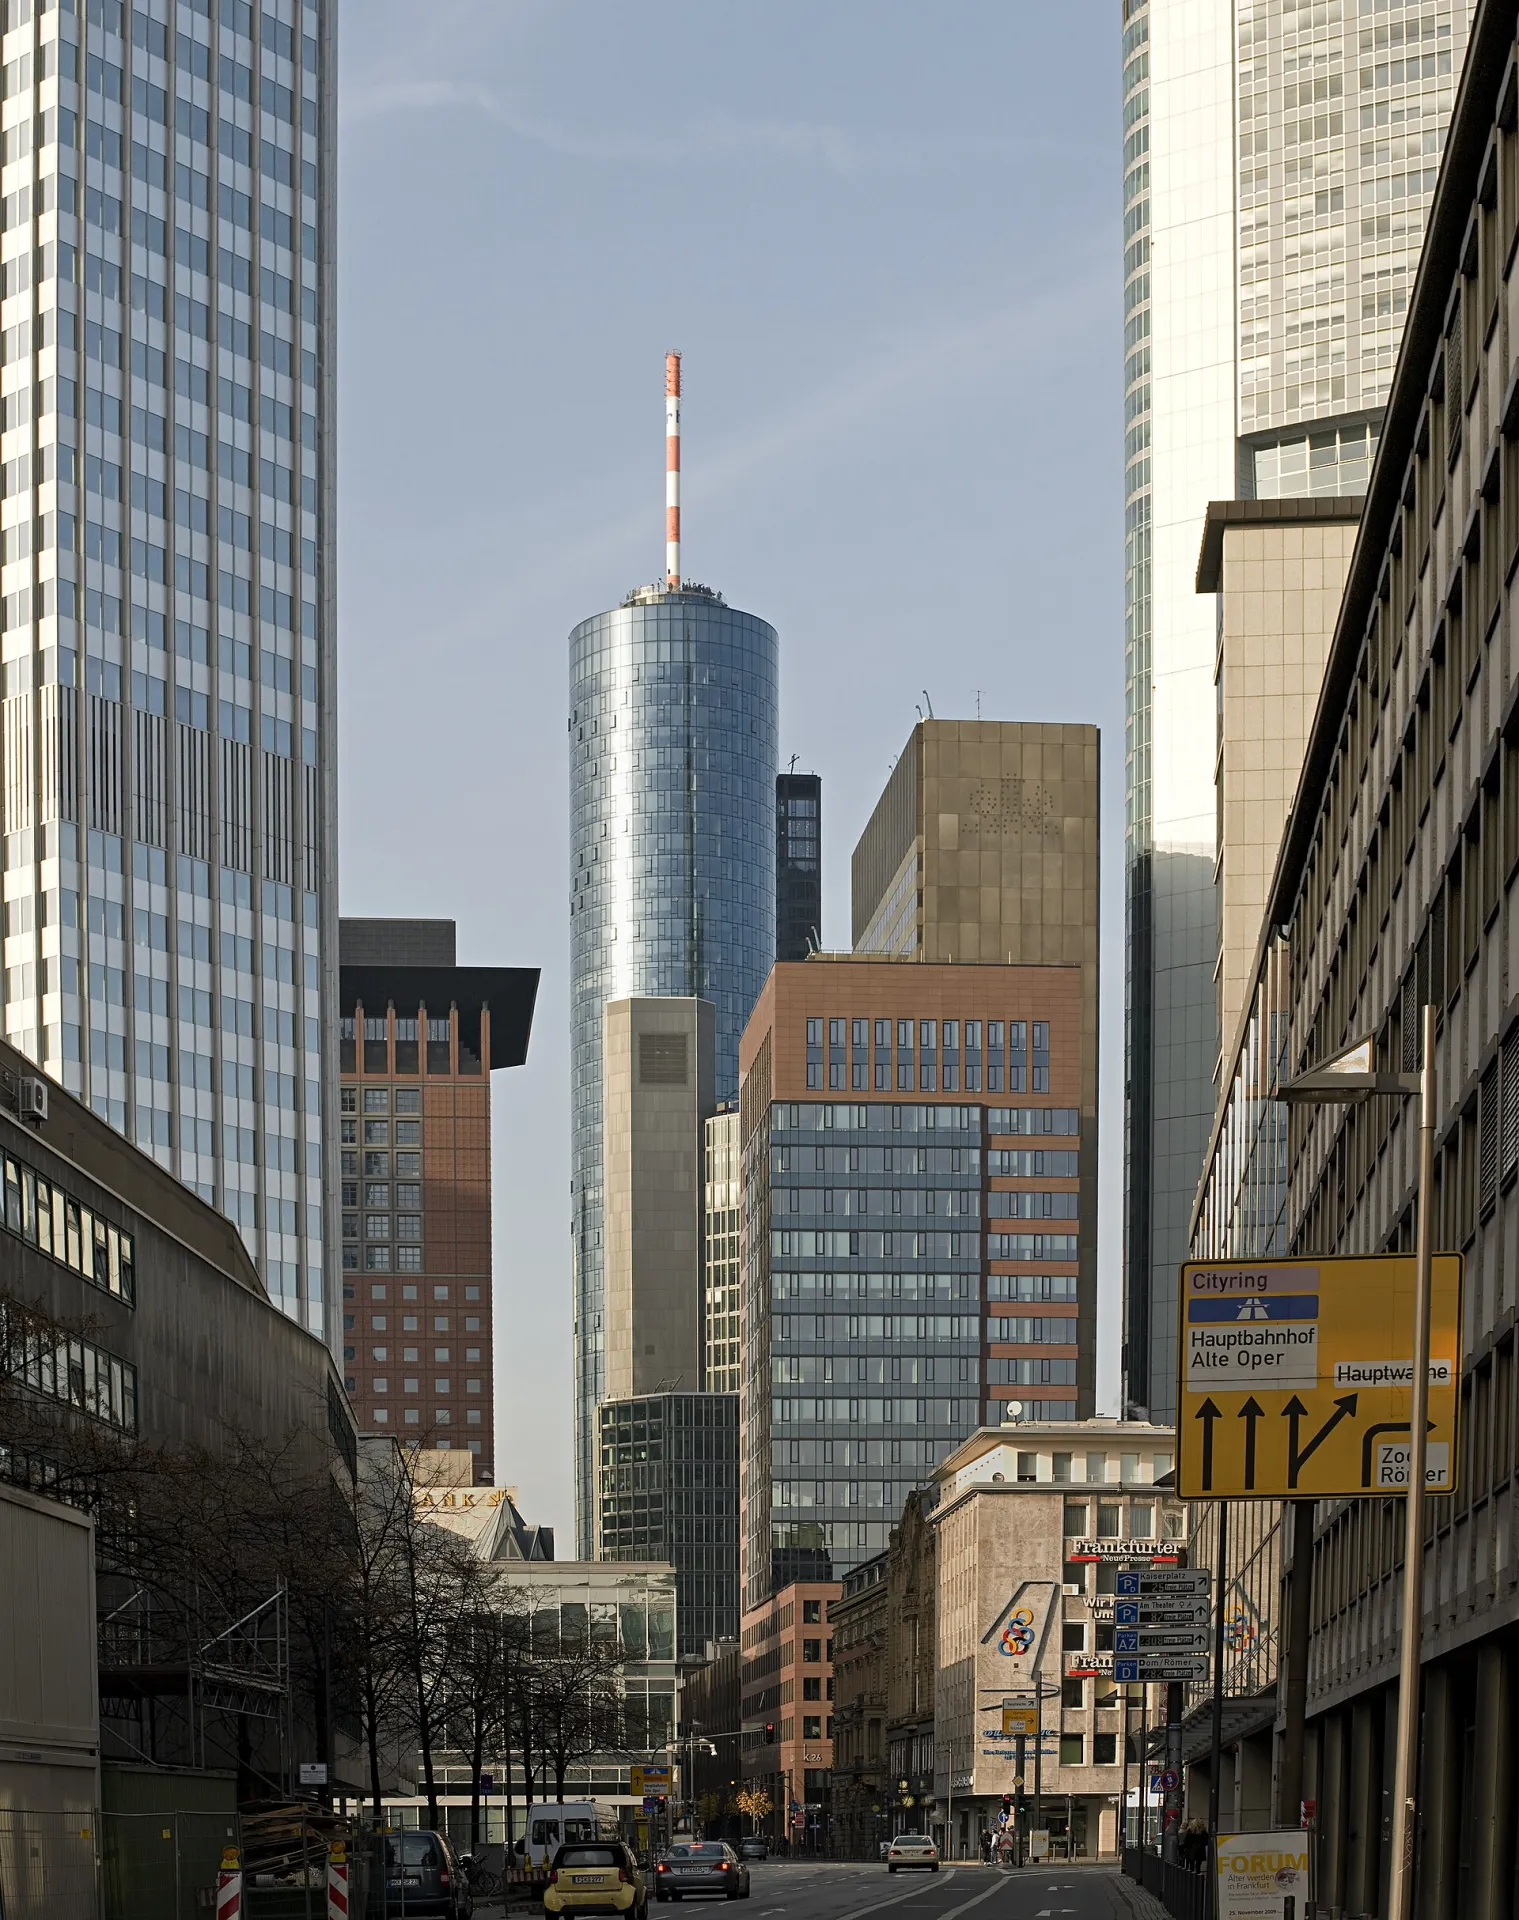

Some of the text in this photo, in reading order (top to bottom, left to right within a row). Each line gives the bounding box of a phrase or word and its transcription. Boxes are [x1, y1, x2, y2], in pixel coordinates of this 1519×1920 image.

[1192, 1272, 1269, 1292] Cityring
[1191, 1327, 1316, 1350] Hauptbahnhof
[1191, 1349, 1285, 1370] Alte Oper
[1337, 1365, 1448, 1385] Hauptwae
[1381, 1447, 1411, 1464] Zo
[1380, 1466, 1447, 1483] Röer
[1071, 1538, 1182, 1555] Frankfurter
[1140, 1572, 1186, 1582] Kaiserplatz
[1151, 1582, 1165, 1593] 25
[1082, 1597, 1106, 1608] Wir
[1152, 1601, 1175, 1609] Theater
[1150, 1612, 1164, 1622] 87
[1118, 1638, 1137, 1650] AZ
[1121, 1667, 1131, 1679] D
[803, 1743, 822, 1762] k.26
[1218, 1852, 1308, 1874] FORUM
[1227, 1873, 1275, 1882] Älter werden
[1236, 1882, 1270, 1890] Frankfurt
